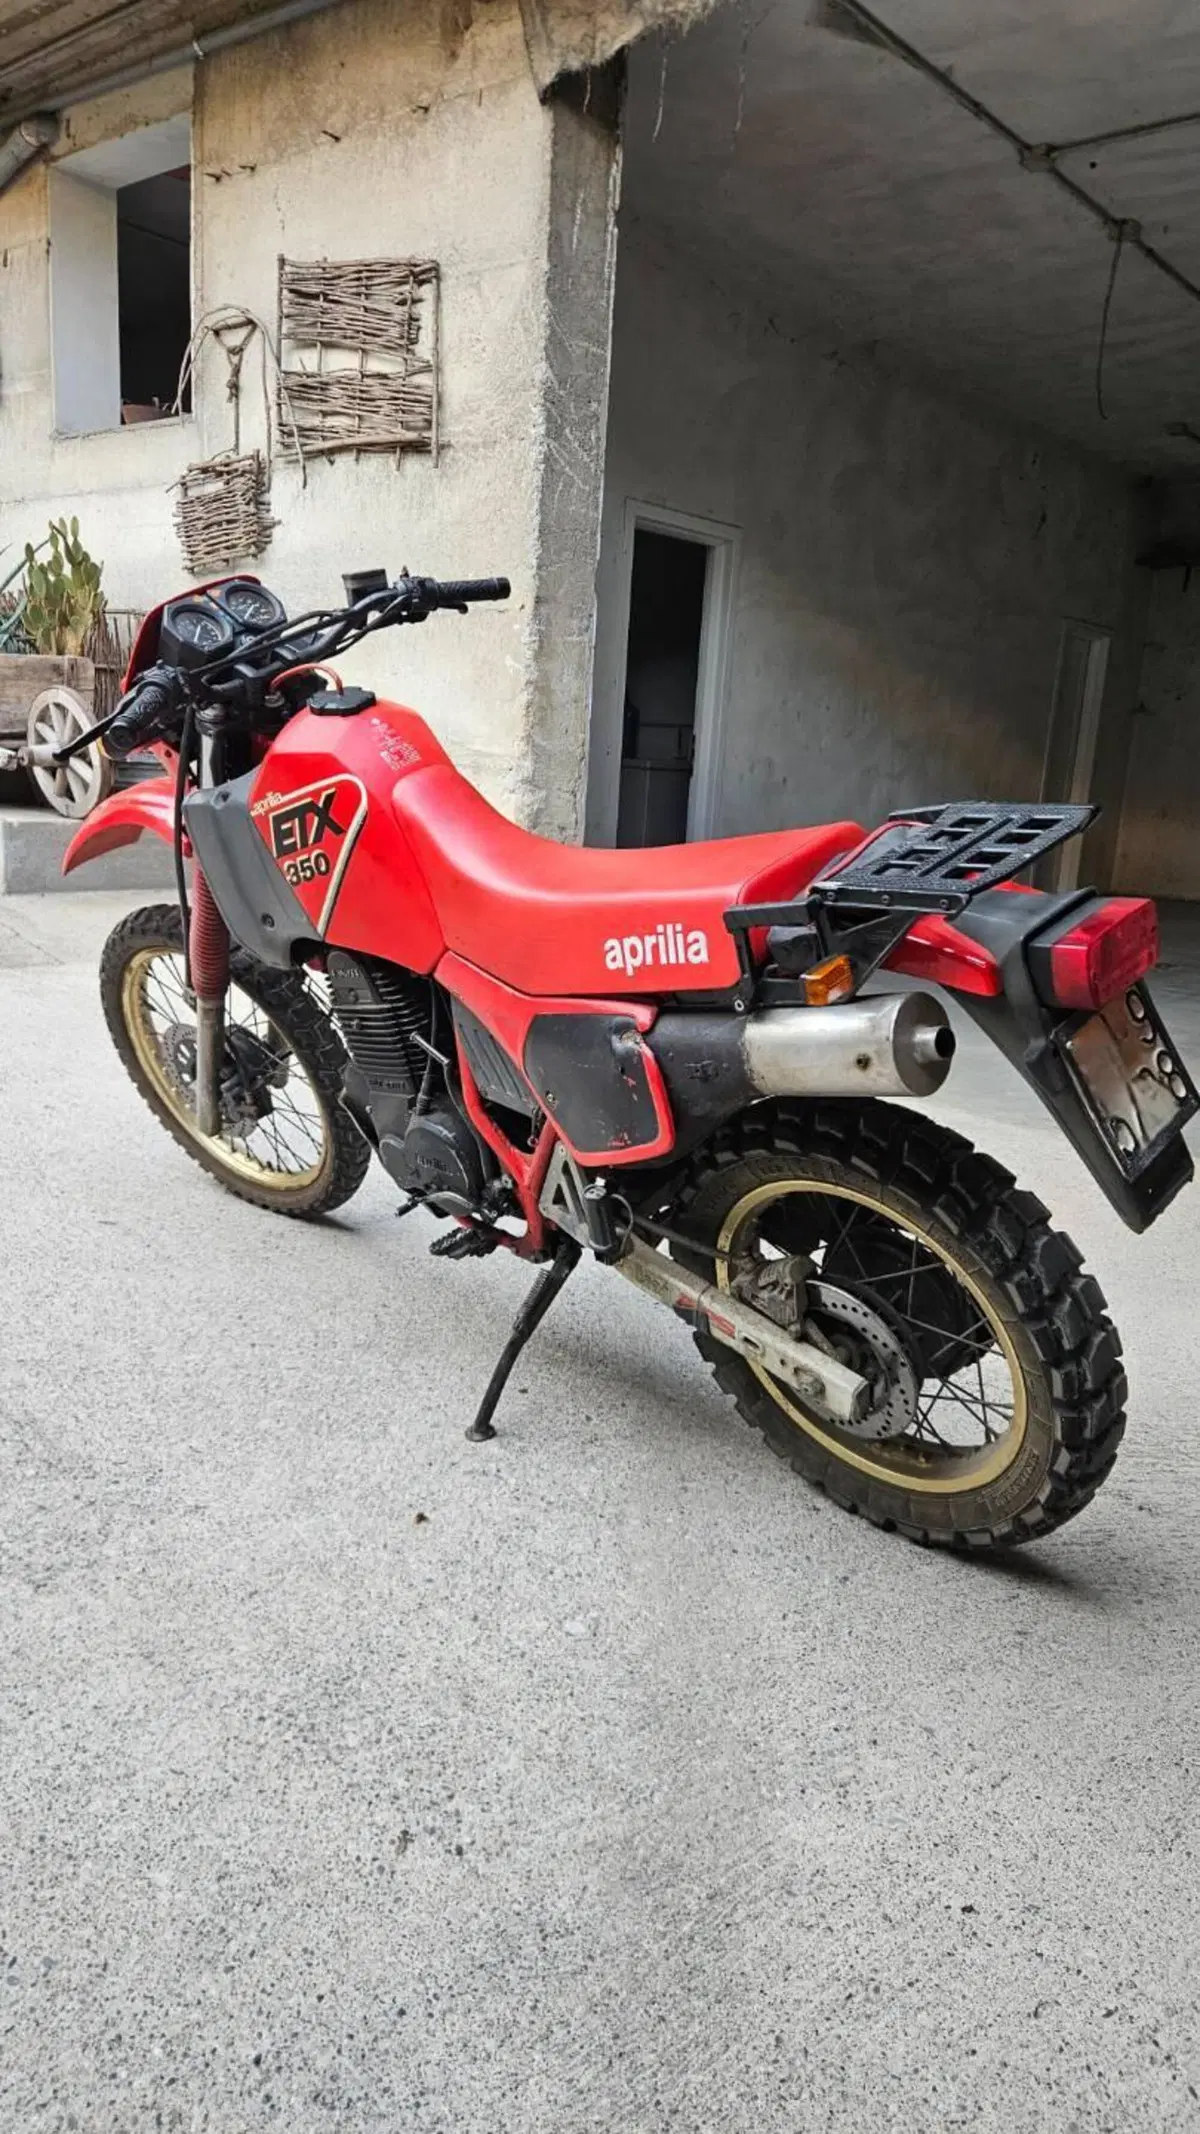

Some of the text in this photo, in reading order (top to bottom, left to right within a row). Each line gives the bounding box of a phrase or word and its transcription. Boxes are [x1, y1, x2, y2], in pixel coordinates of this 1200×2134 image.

[269, 787, 346, 858] ETX
[284, 850, 330, 886] 350
[604, 922, 709, 976] aprilia
